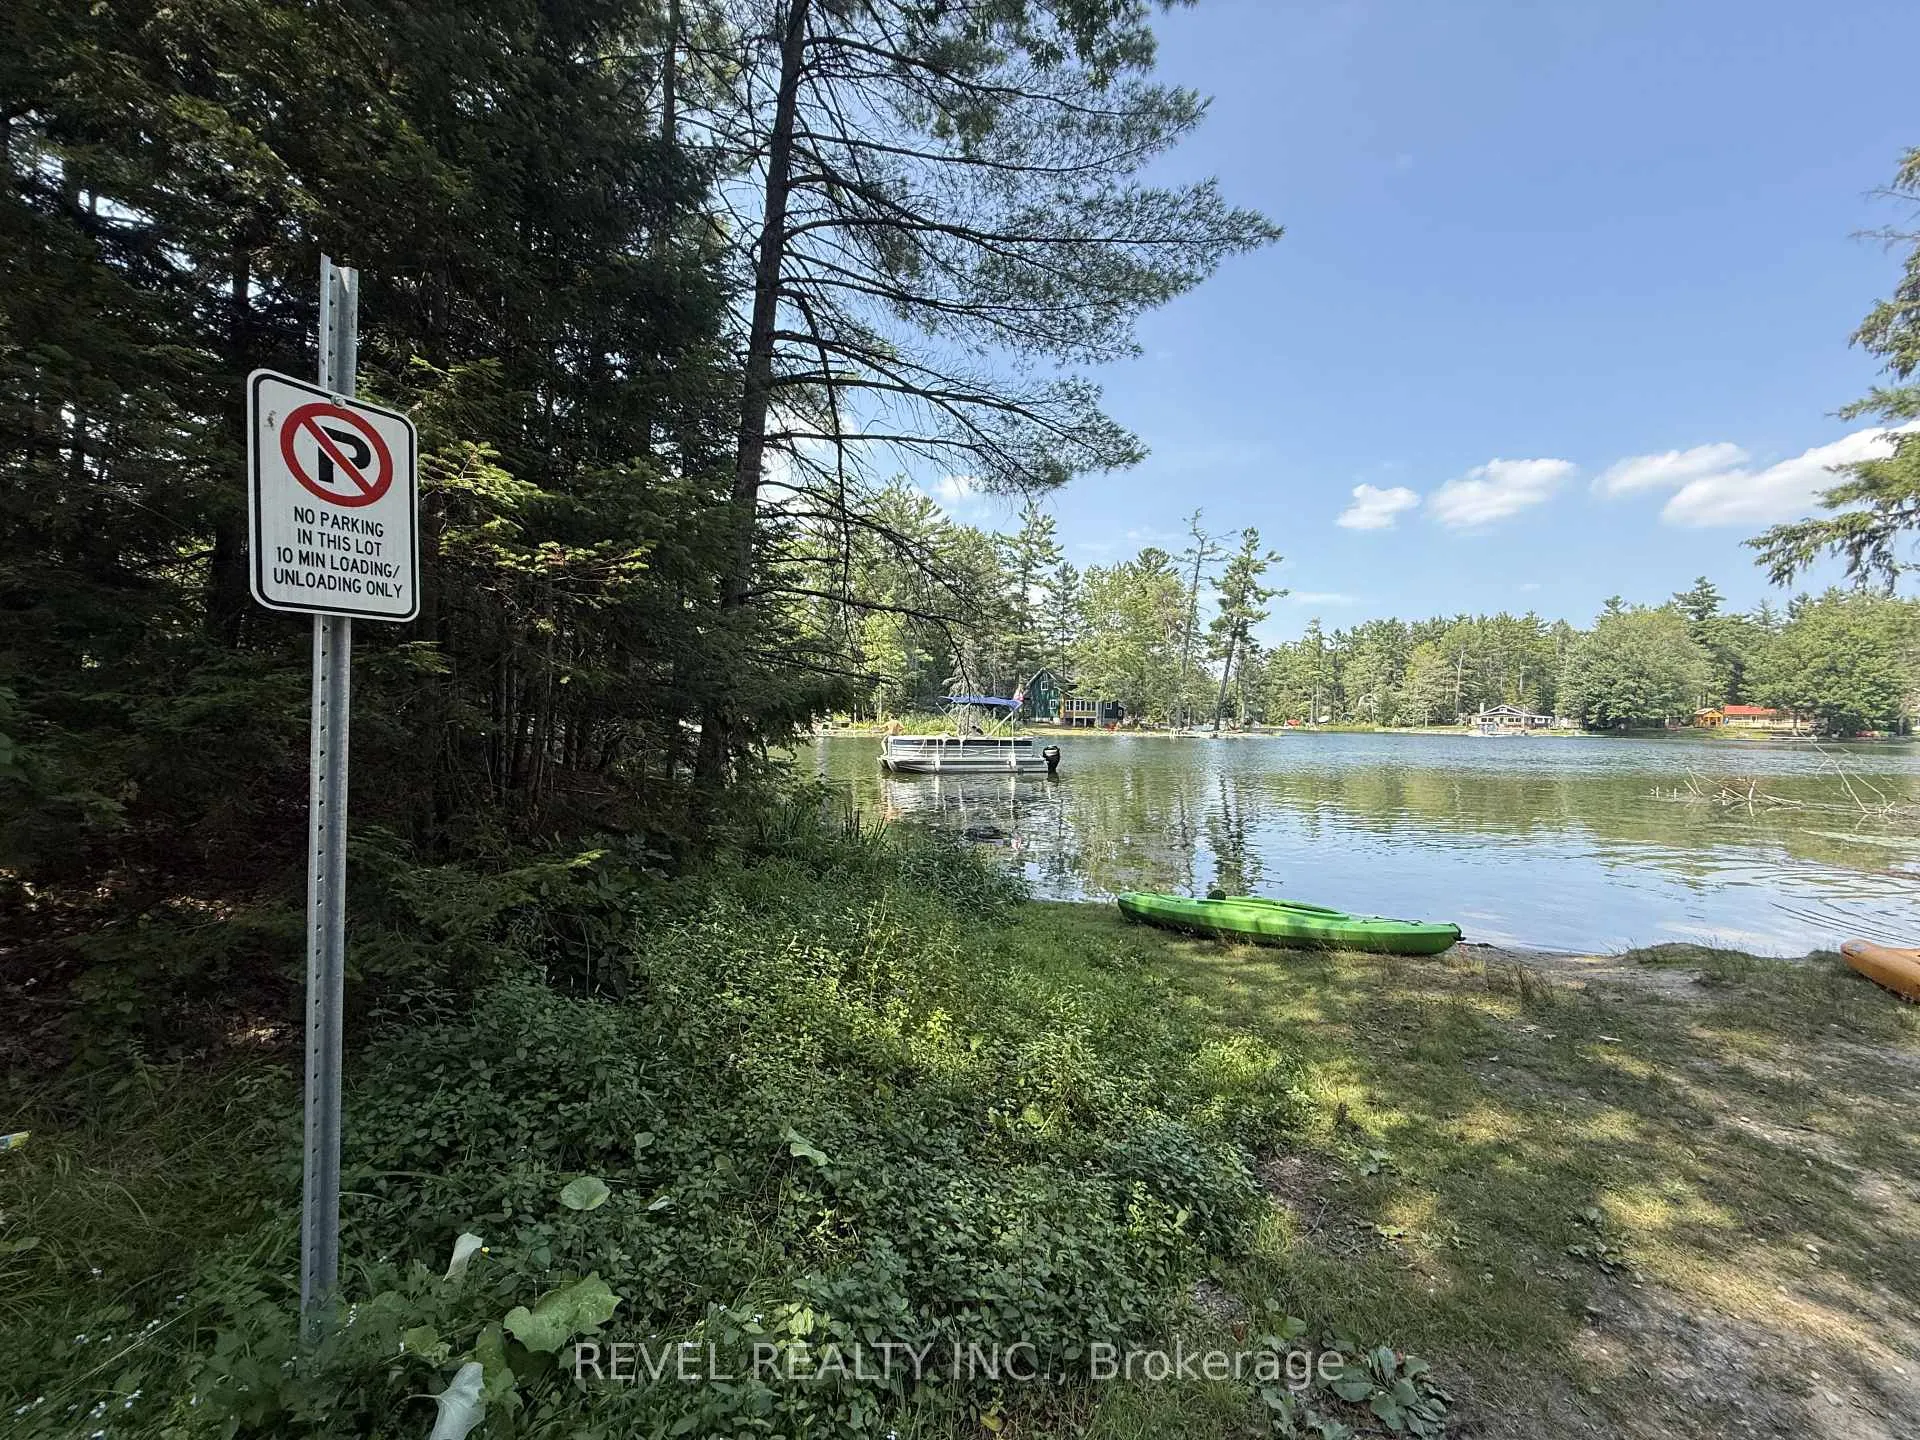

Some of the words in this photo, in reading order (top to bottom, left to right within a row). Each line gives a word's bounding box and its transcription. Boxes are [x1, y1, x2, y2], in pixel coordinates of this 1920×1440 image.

[294, 506, 315, 525] NO
[320, 512, 384, 537] PARKING
[297, 528, 312, 546] IN
[317, 532, 351, 552] THIS
[355, 540, 382, 557] LOT
[276, 546, 293, 563] 10
[299, 551, 326, 569] MIN
[330, 556, 400, 578] LOADING/
[273, 567, 361, 593] UNLOADING
[366, 580, 403, 599] ONLY
